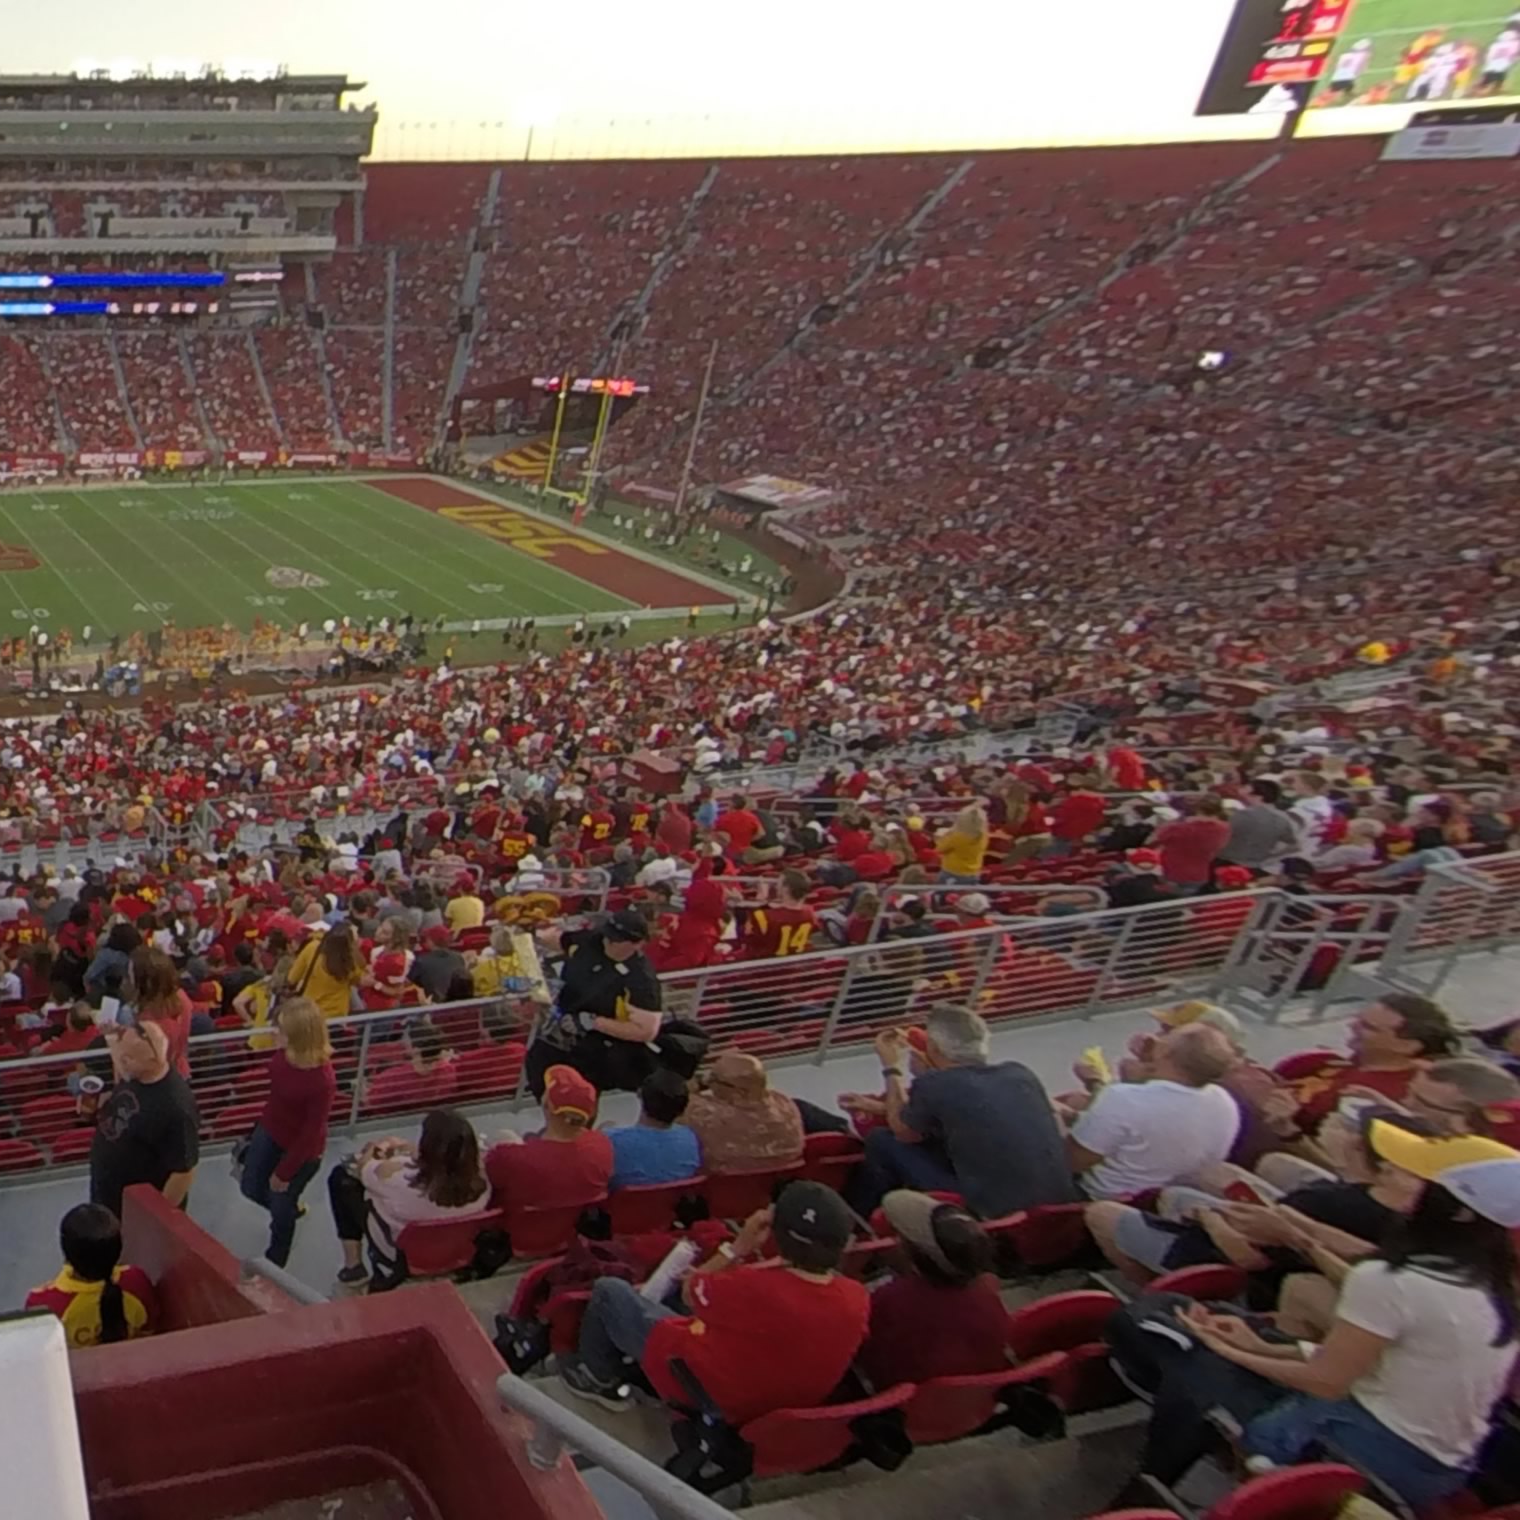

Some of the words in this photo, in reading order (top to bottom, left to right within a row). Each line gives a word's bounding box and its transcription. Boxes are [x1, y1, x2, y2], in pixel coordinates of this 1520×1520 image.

[436, 505, 611, 557] USC
[501, 838, 526, 857] 55
[776, 922, 811, 955] 14
